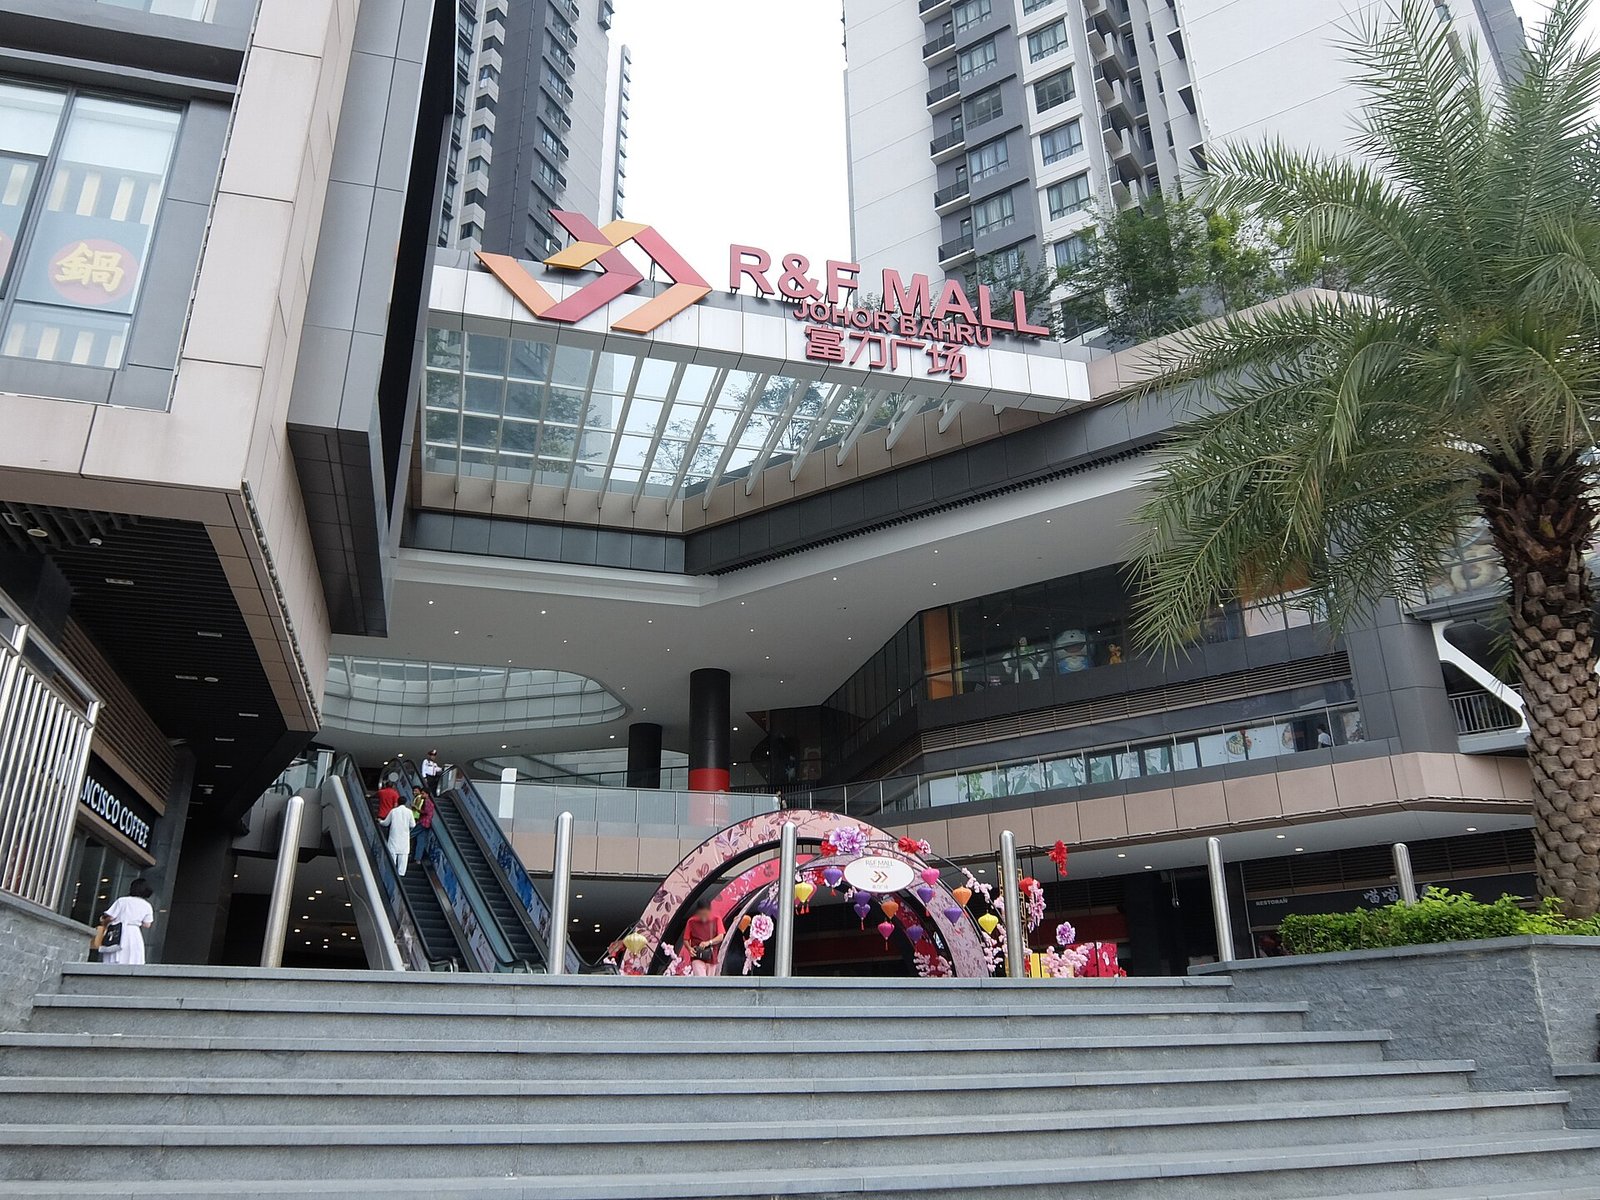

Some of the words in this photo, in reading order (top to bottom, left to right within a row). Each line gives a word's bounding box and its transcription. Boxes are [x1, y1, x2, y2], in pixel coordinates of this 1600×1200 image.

[55, 241, 124, 292] 鍋
[730, 244, 860, 305] R&F
[882, 268, 1049, 336] MALL
[793, 300, 893, 333] JOHOR
[900, 315, 992, 347] BAHRU
[804, 325, 967, 379] 富力广场
[80, 775, 120, 824] NCISCO
[119, 806, 150, 848] COFFEE
[1255, 897, 1288, 906] RESTORAN
